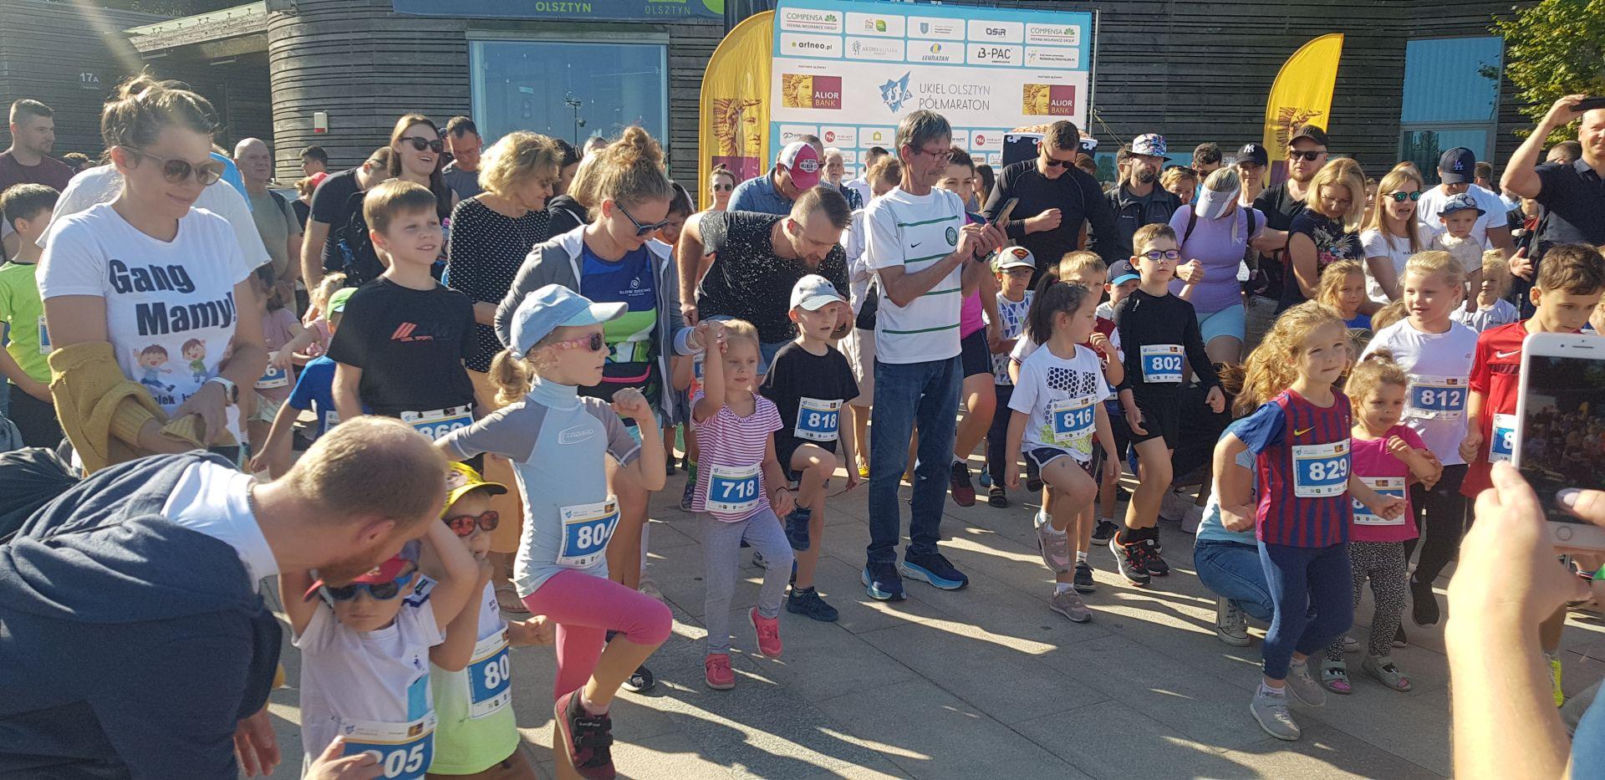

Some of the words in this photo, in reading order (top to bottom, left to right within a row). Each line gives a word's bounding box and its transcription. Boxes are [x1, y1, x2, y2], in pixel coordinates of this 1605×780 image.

[535, 2, 592, 13] OLSZTYN
[644, 5, 691, 15] OLSZTYN
[786, 12, 823, 21] COMPENSA
[798, 41, 833, 51] artneo.pl
[814, 91, 840, 100] ALIOR
[919, 83, 946, 95] UKIEL
[948, 84, 991, 96] OLSZTYN
[815, 99, 836, 107] BANK
[918, 96, 990, 111] PÓŁMARATON
[1050, 99, 1073, 107] ALIOR
[108, 258, 196, 296] Gang
[135, 291, 236, 337] Mamy!
[1151, 356, 1182, 371] 802
[1420, 390, 1460, 407] 812
[807, 411, 837, 429] 818
[1063, 407, 1091, 428] 816
[1309, 458, 1348, 481] 829
[721, 479, 755, 498] 718
